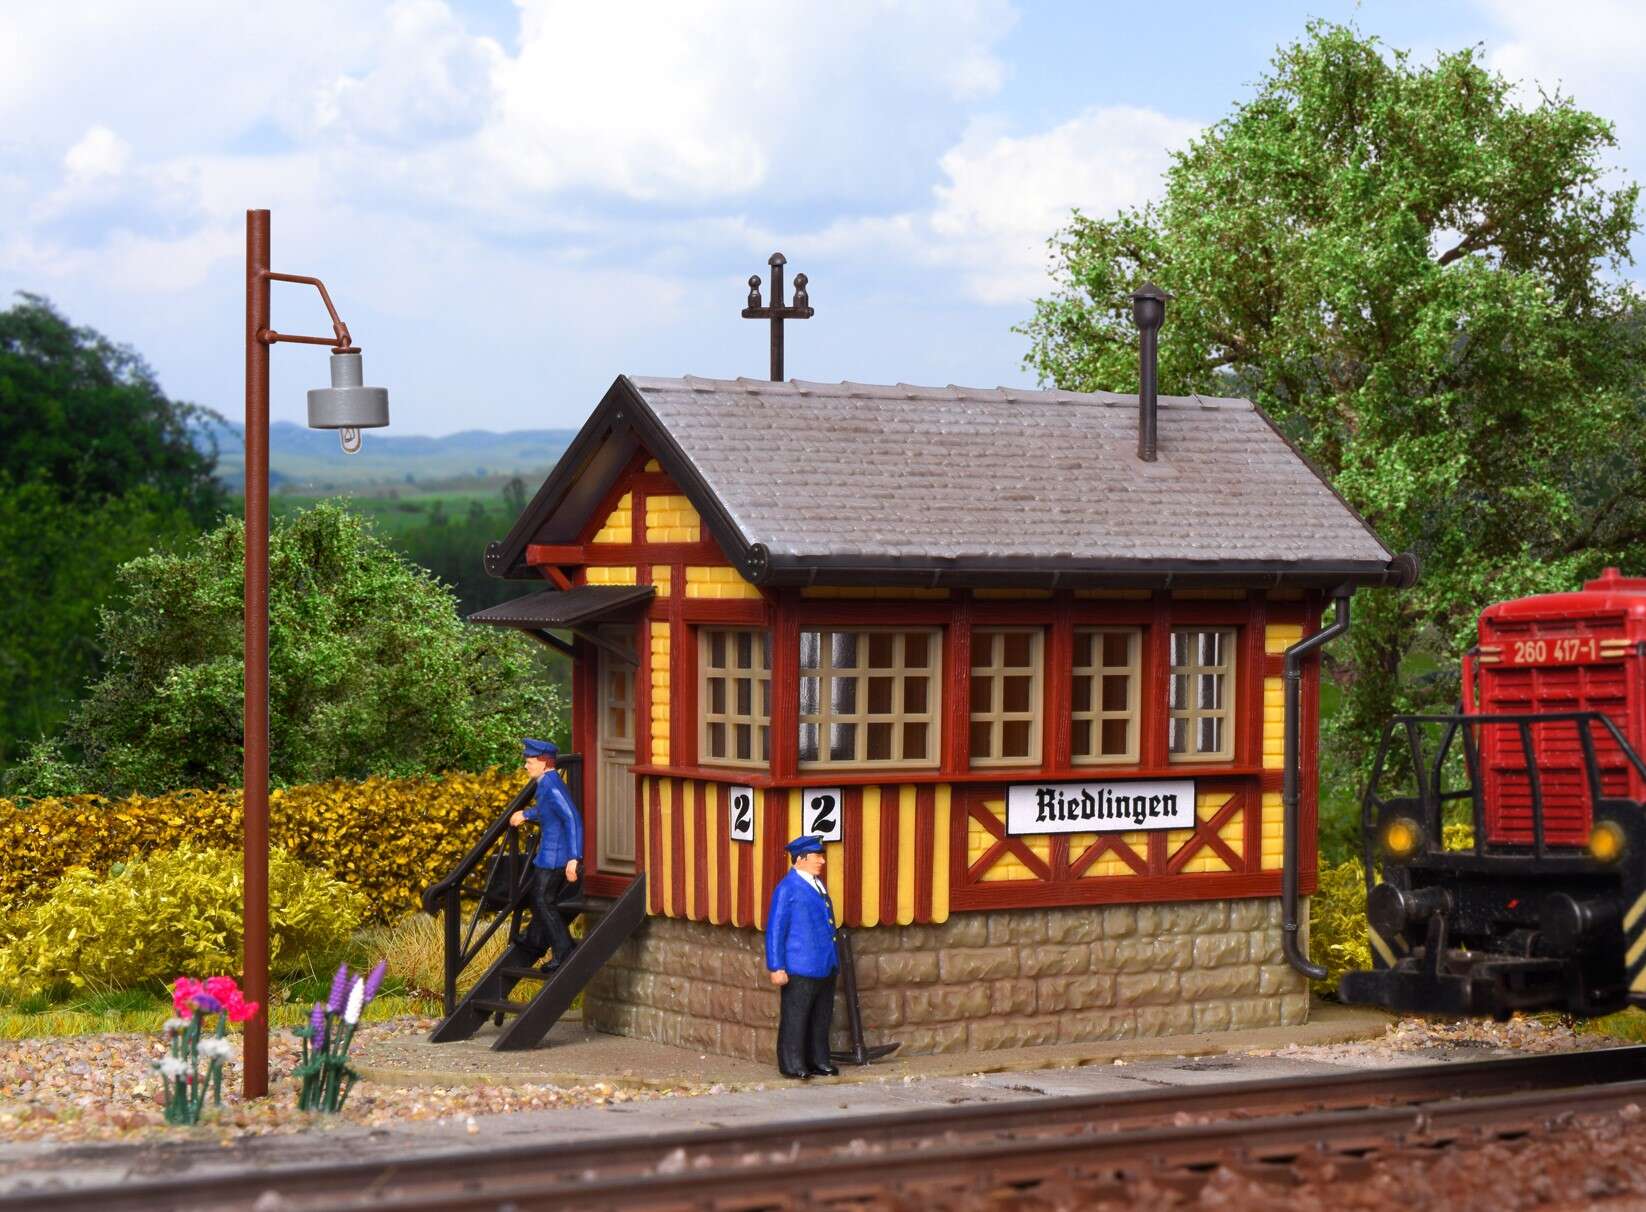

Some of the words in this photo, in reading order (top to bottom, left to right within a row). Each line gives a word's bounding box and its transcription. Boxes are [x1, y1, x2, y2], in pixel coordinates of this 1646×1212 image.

[1514, 641, 1547, 663] 260
[1554, 639, 1596, 661] 417-1
[734, 794, 751, 833] 2
[811, 795, 836, 833] 2
[1036, 788, 1178, 825] Riedlingen
